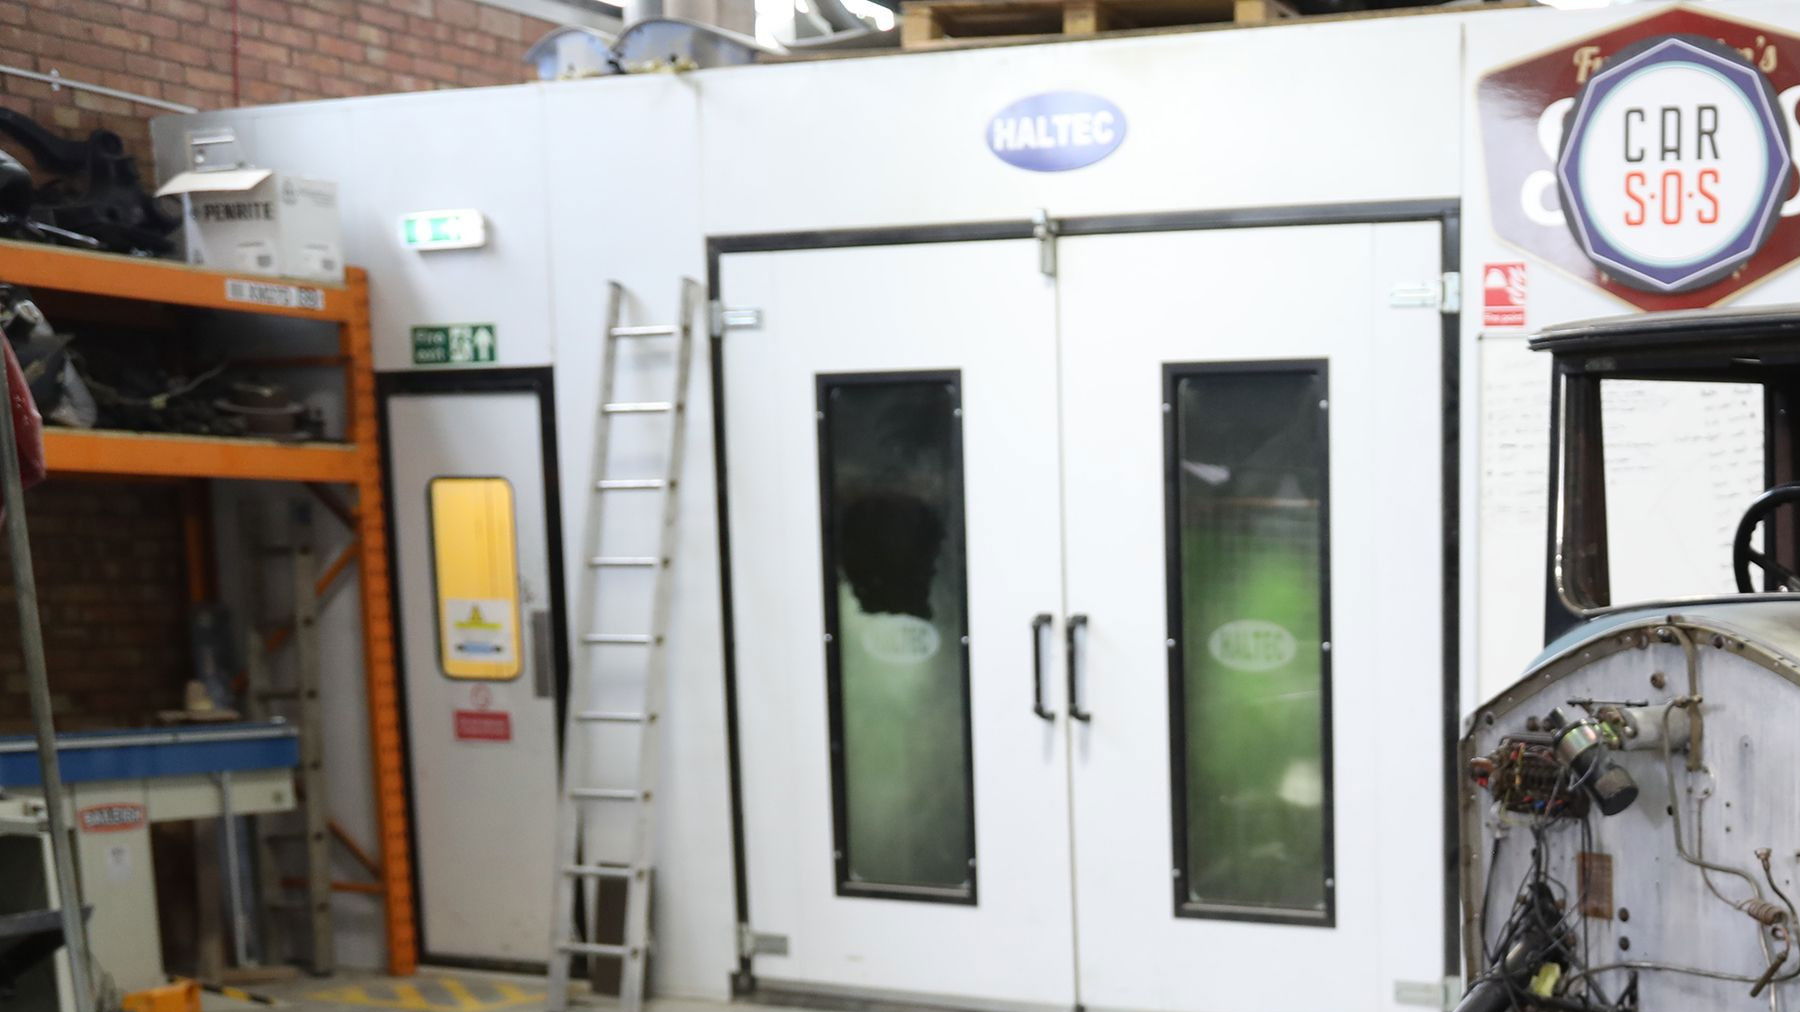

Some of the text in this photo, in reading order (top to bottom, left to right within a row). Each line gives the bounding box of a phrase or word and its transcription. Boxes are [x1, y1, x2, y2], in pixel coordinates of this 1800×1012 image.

[992, 109, 1116, 151] HALTEC
[1624, 104, 1720, 163] CAR
[205, 203, 274, 221] PENRITE
